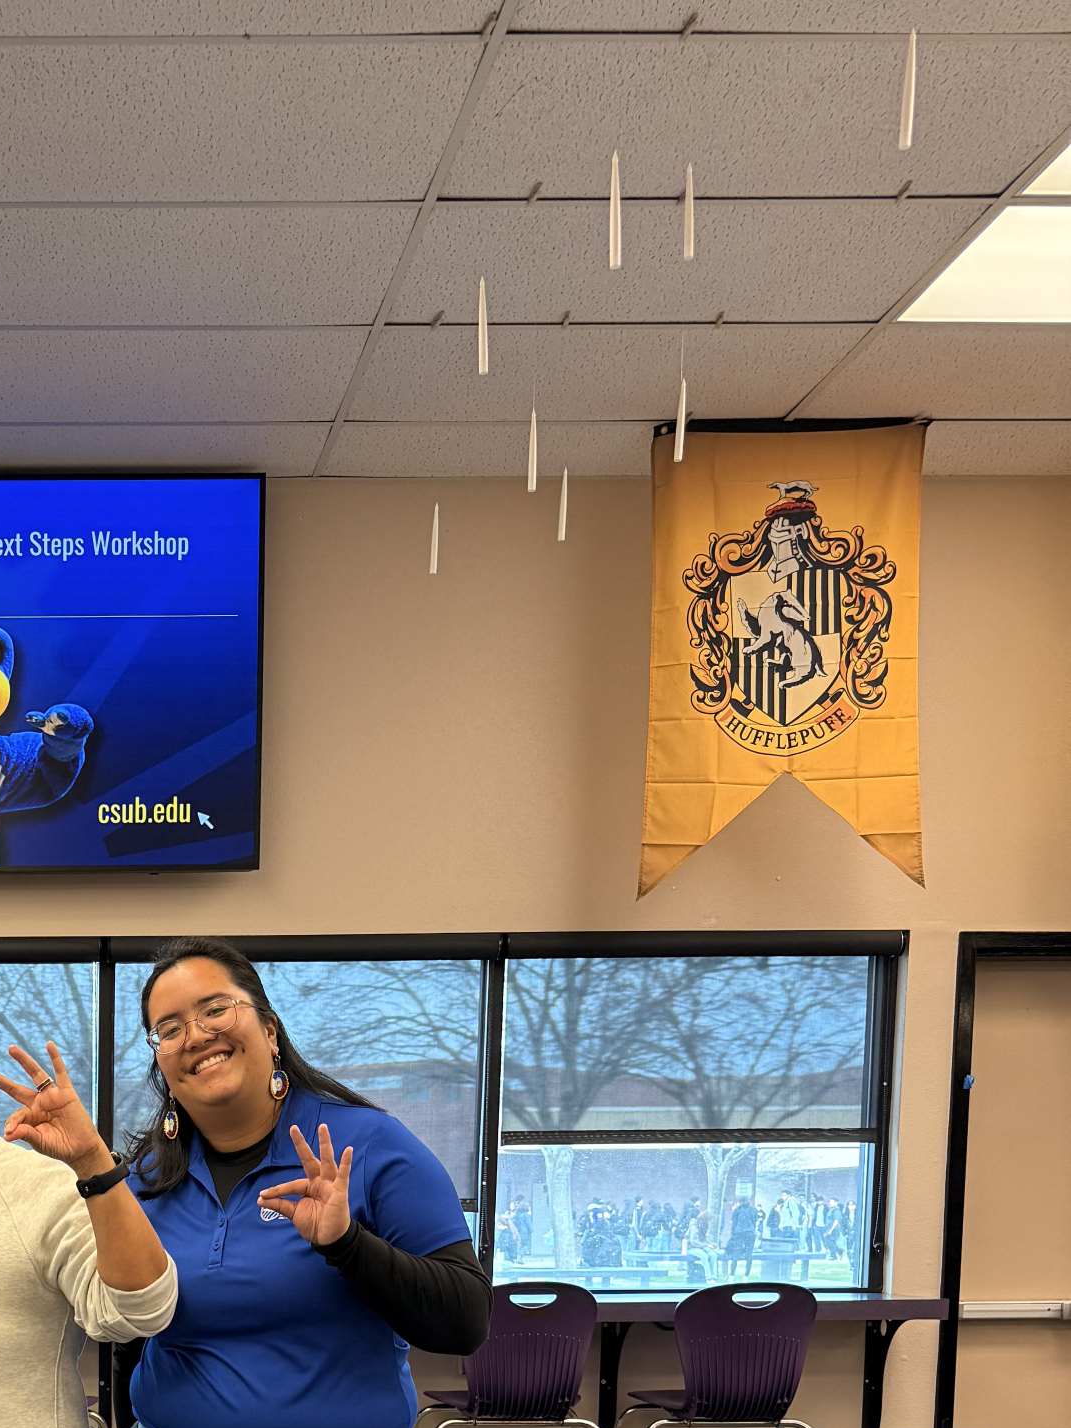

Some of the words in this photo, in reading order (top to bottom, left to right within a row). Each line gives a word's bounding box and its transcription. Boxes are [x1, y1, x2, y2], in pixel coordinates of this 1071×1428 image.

[29, 530, 85, 562] Steps
[91, 530, 189, 561] Workshop
[725, 707, 848, 750] HUFFLEPUFF
[97, 795, 191, 824] csub.edu
